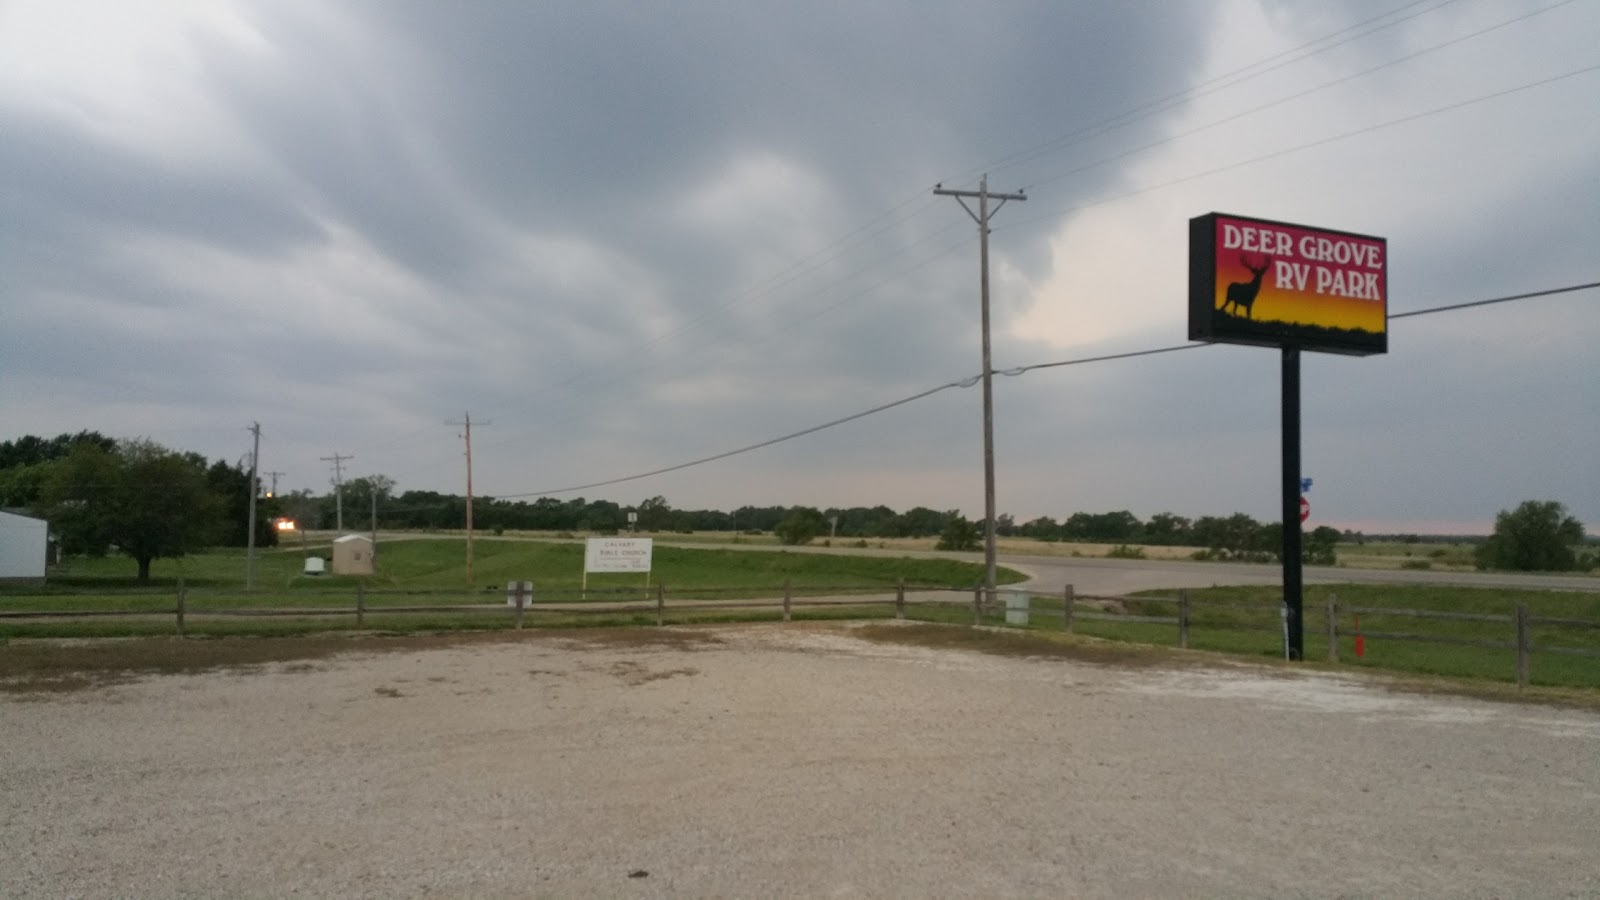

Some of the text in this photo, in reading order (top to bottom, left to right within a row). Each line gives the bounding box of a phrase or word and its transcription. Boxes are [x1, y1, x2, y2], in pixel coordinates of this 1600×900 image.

[1223, 224, 1382, 269] DEER GROVE
[1276, 261, 1381, 301] RV PARK
